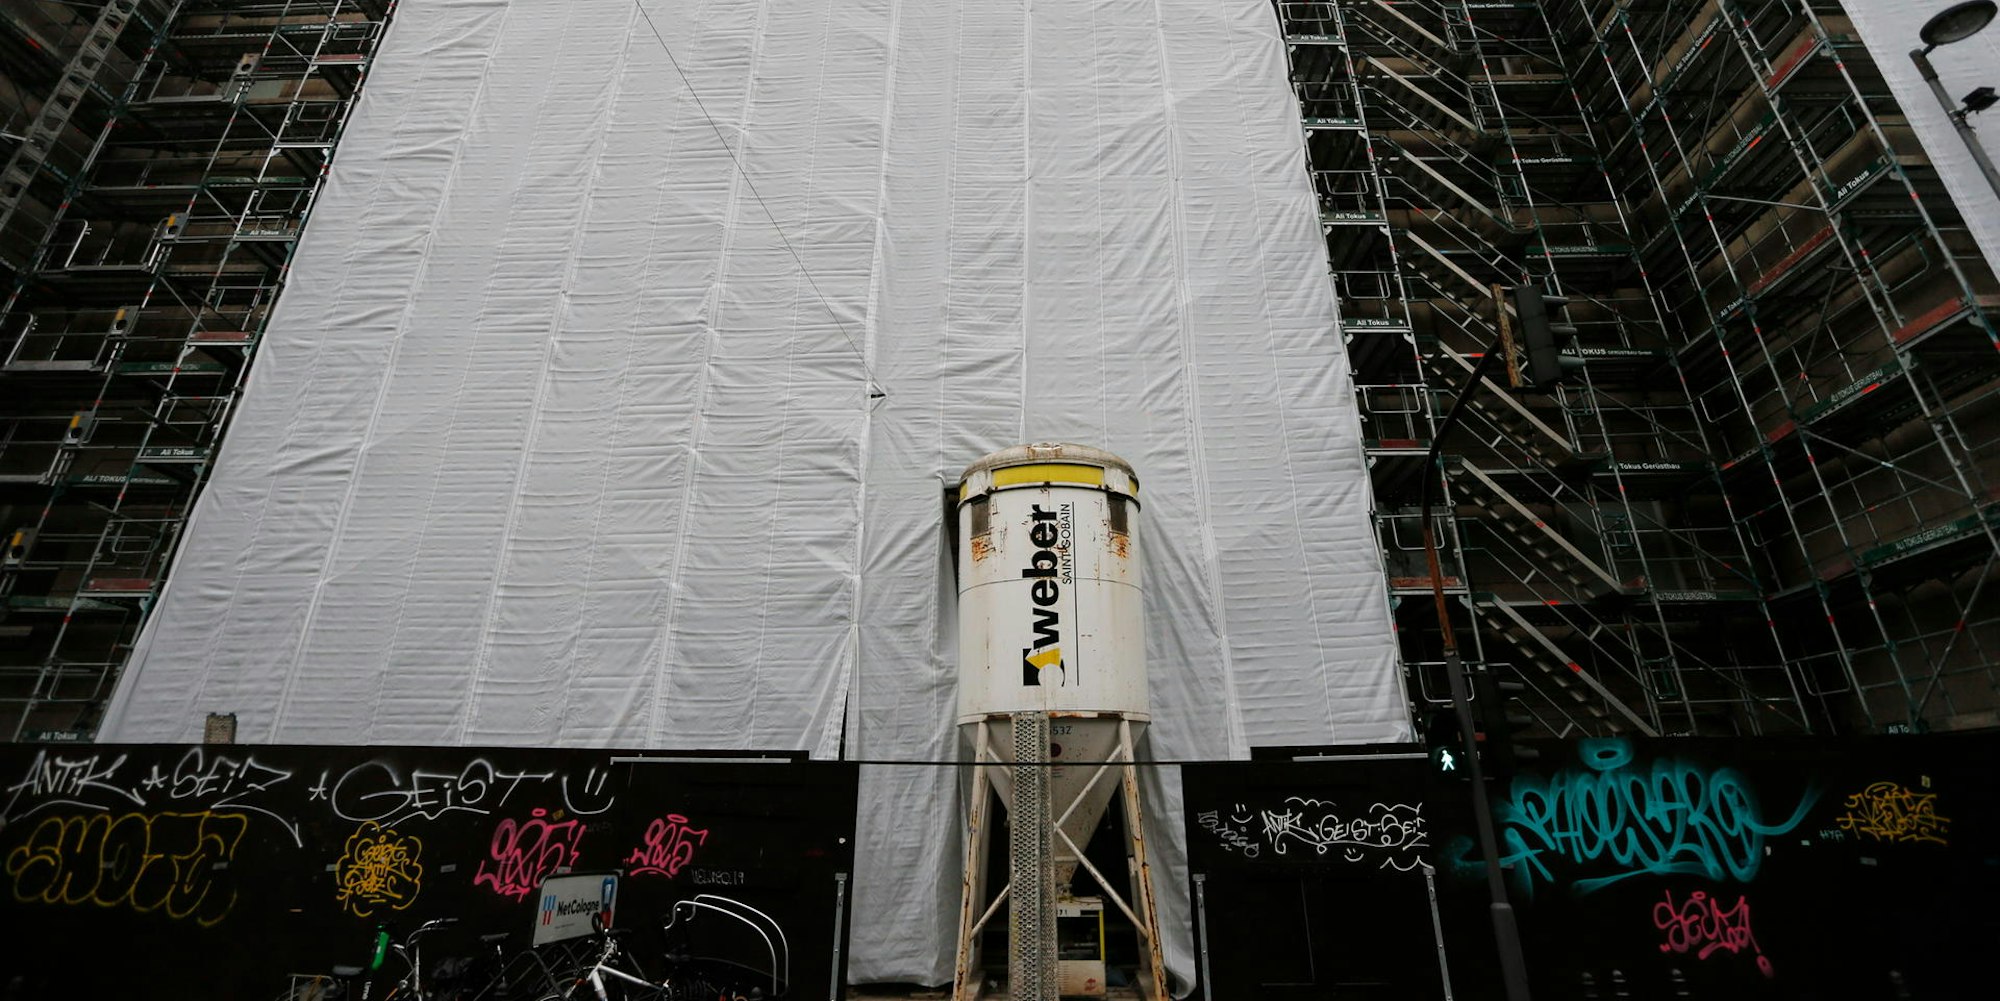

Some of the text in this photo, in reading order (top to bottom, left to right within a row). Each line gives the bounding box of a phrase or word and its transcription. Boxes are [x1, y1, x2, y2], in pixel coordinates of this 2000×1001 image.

[1836, 169, 1870, 199] Ali Tokus
[1022, 503, 1060, 650] weber
[557, 898, 600, 916] NetCologne
